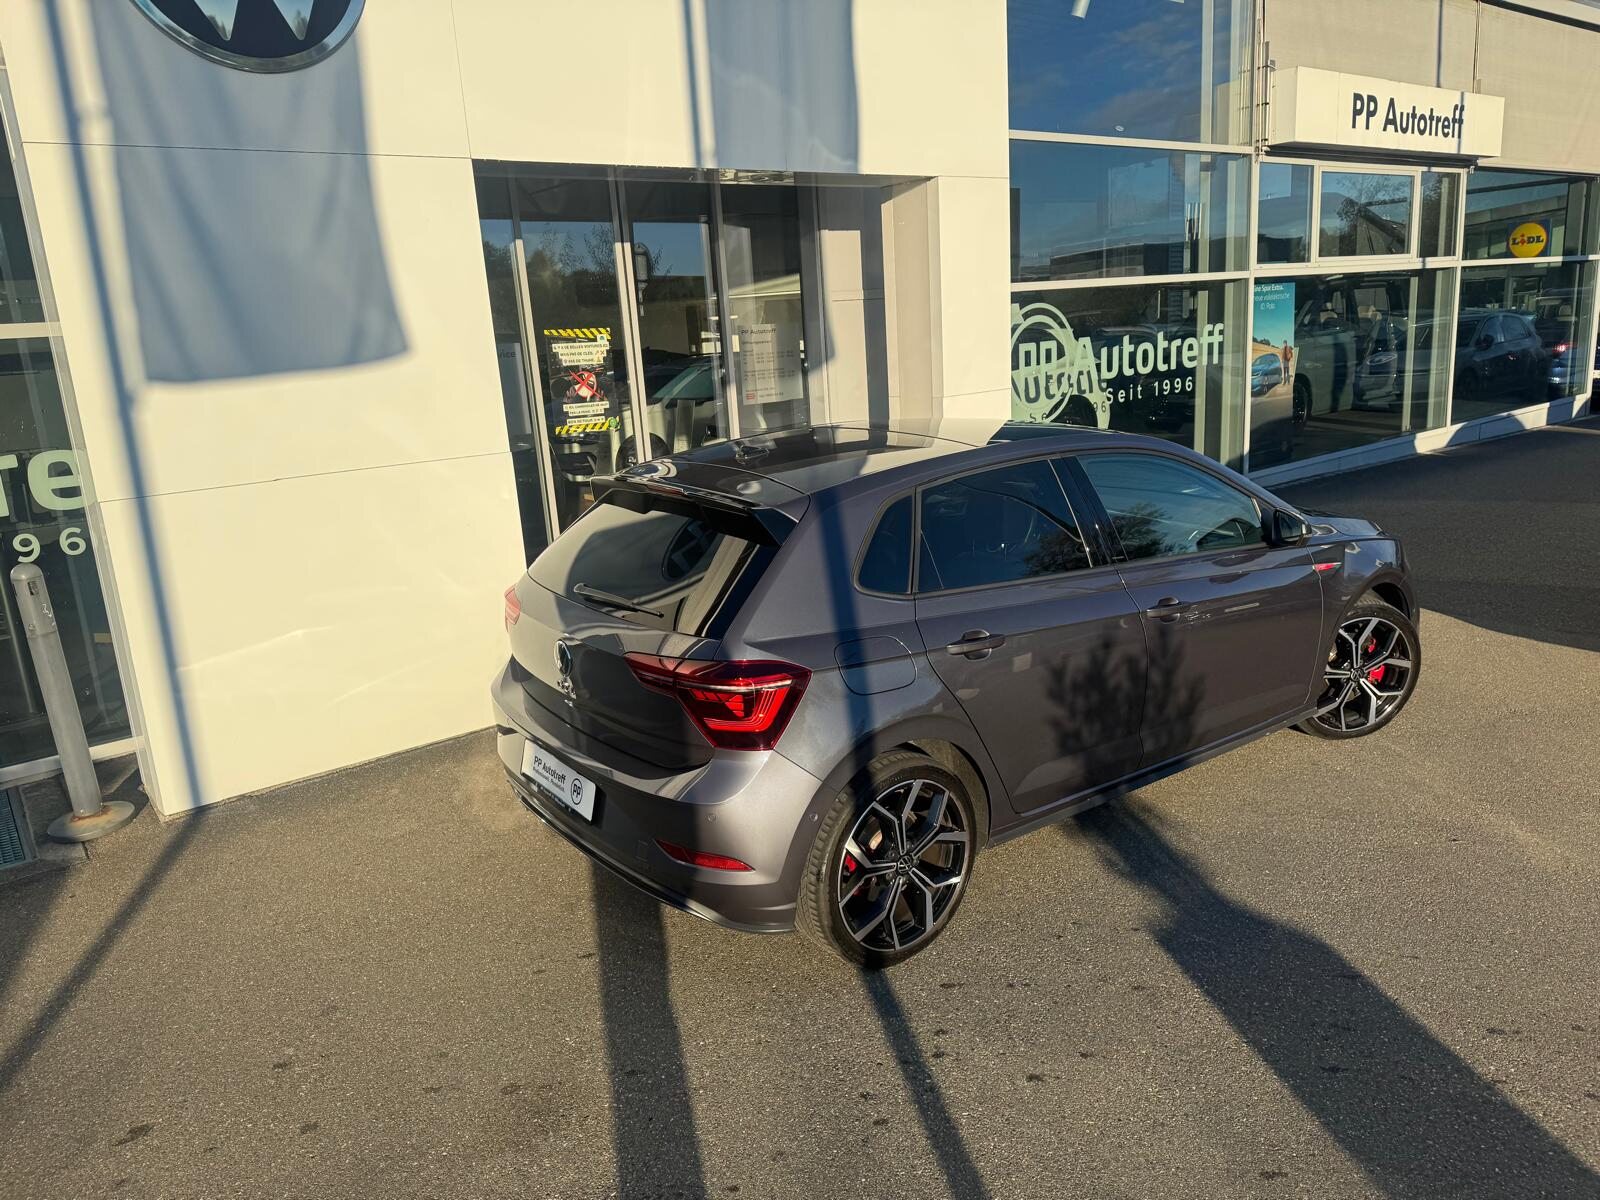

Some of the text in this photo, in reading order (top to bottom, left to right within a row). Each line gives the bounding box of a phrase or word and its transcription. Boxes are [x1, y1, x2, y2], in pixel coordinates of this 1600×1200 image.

[1351, 92, 1465, 139] PP Autotreff
[1510, 233, 1545, 246] LIDL
[1072, 322, 1225, 388] Autotreff
[1105, 383, 1143, 405] Seit
[1153, 376, 1194, 398] 1996
[533, 755, 543, 767] PP
[542, 762, 567, 785] Autotreff
